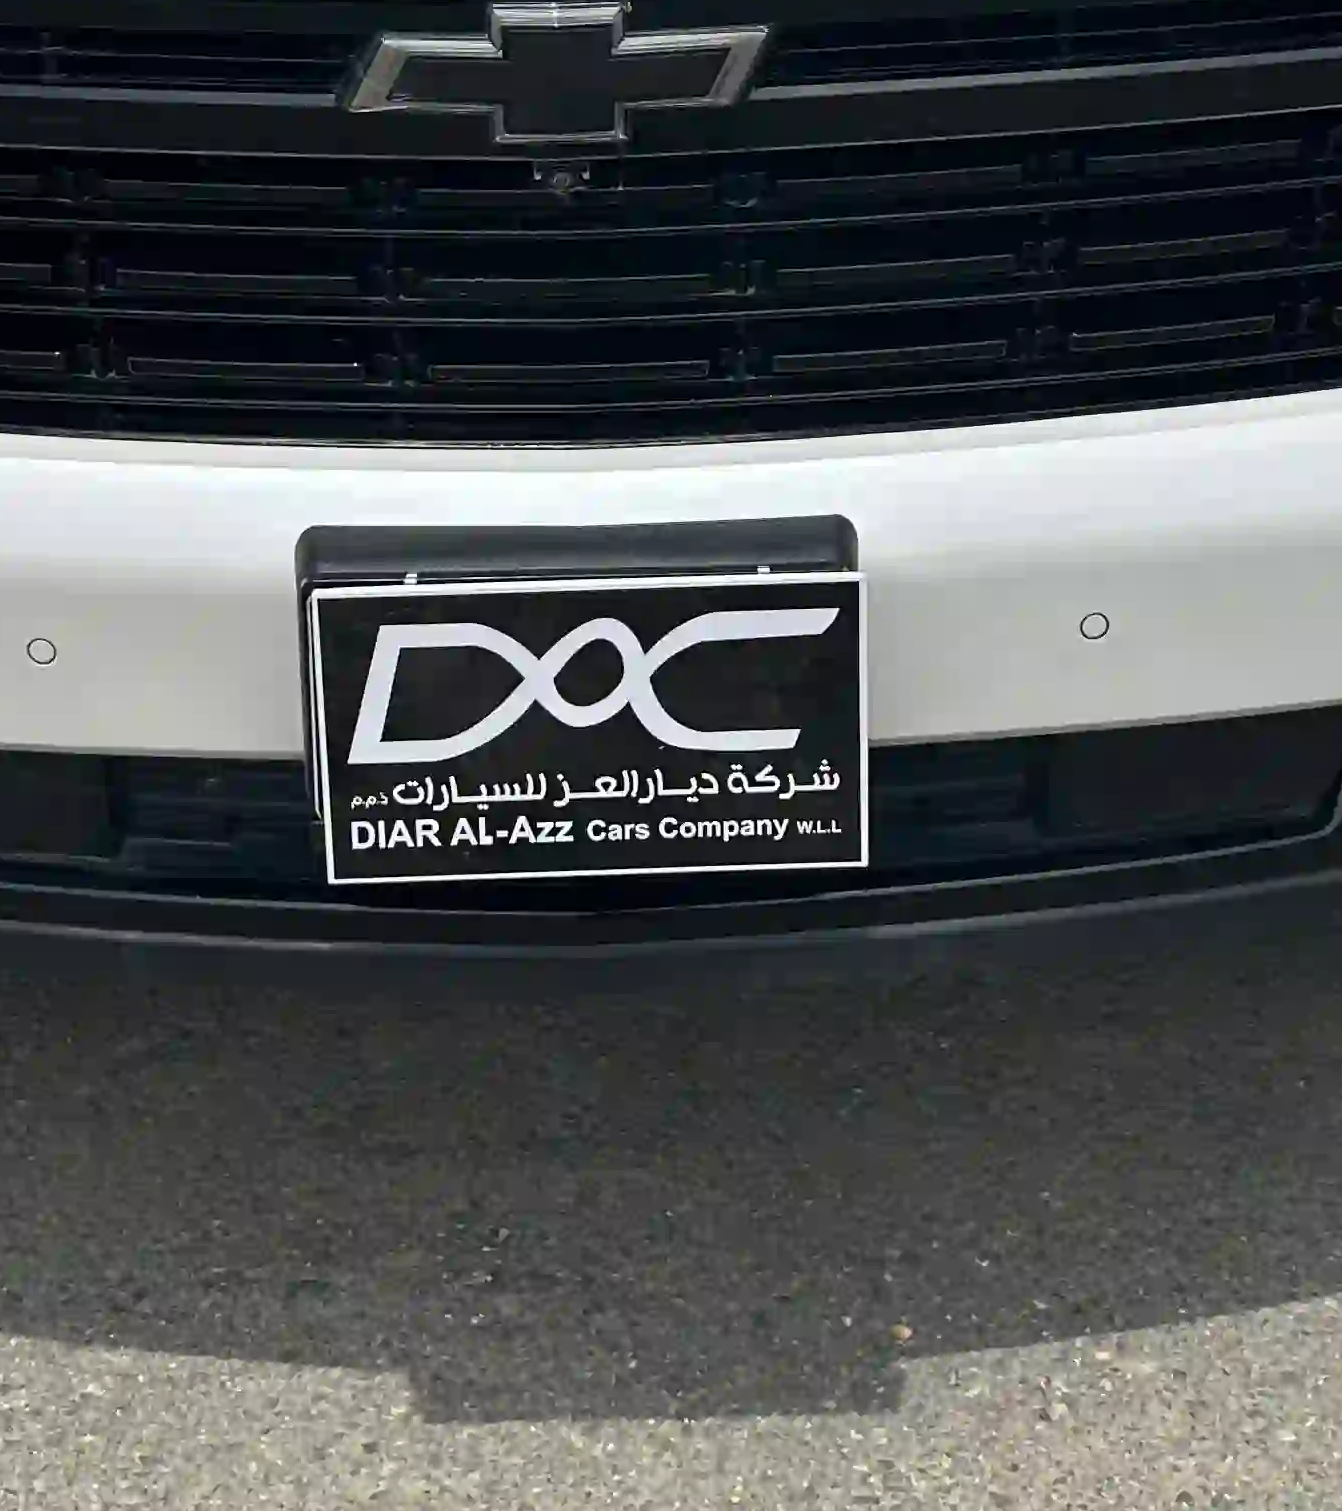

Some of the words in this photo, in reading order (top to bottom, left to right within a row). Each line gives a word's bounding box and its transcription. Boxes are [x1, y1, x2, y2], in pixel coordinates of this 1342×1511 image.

[392, 772, 547, 811] للسيارات
[726, 758, 841, 800] شركة
[350, 818, 442, 850] DIAR
[586, 819, 651, 841] Cars
[658, 816, 790, 842] Company
